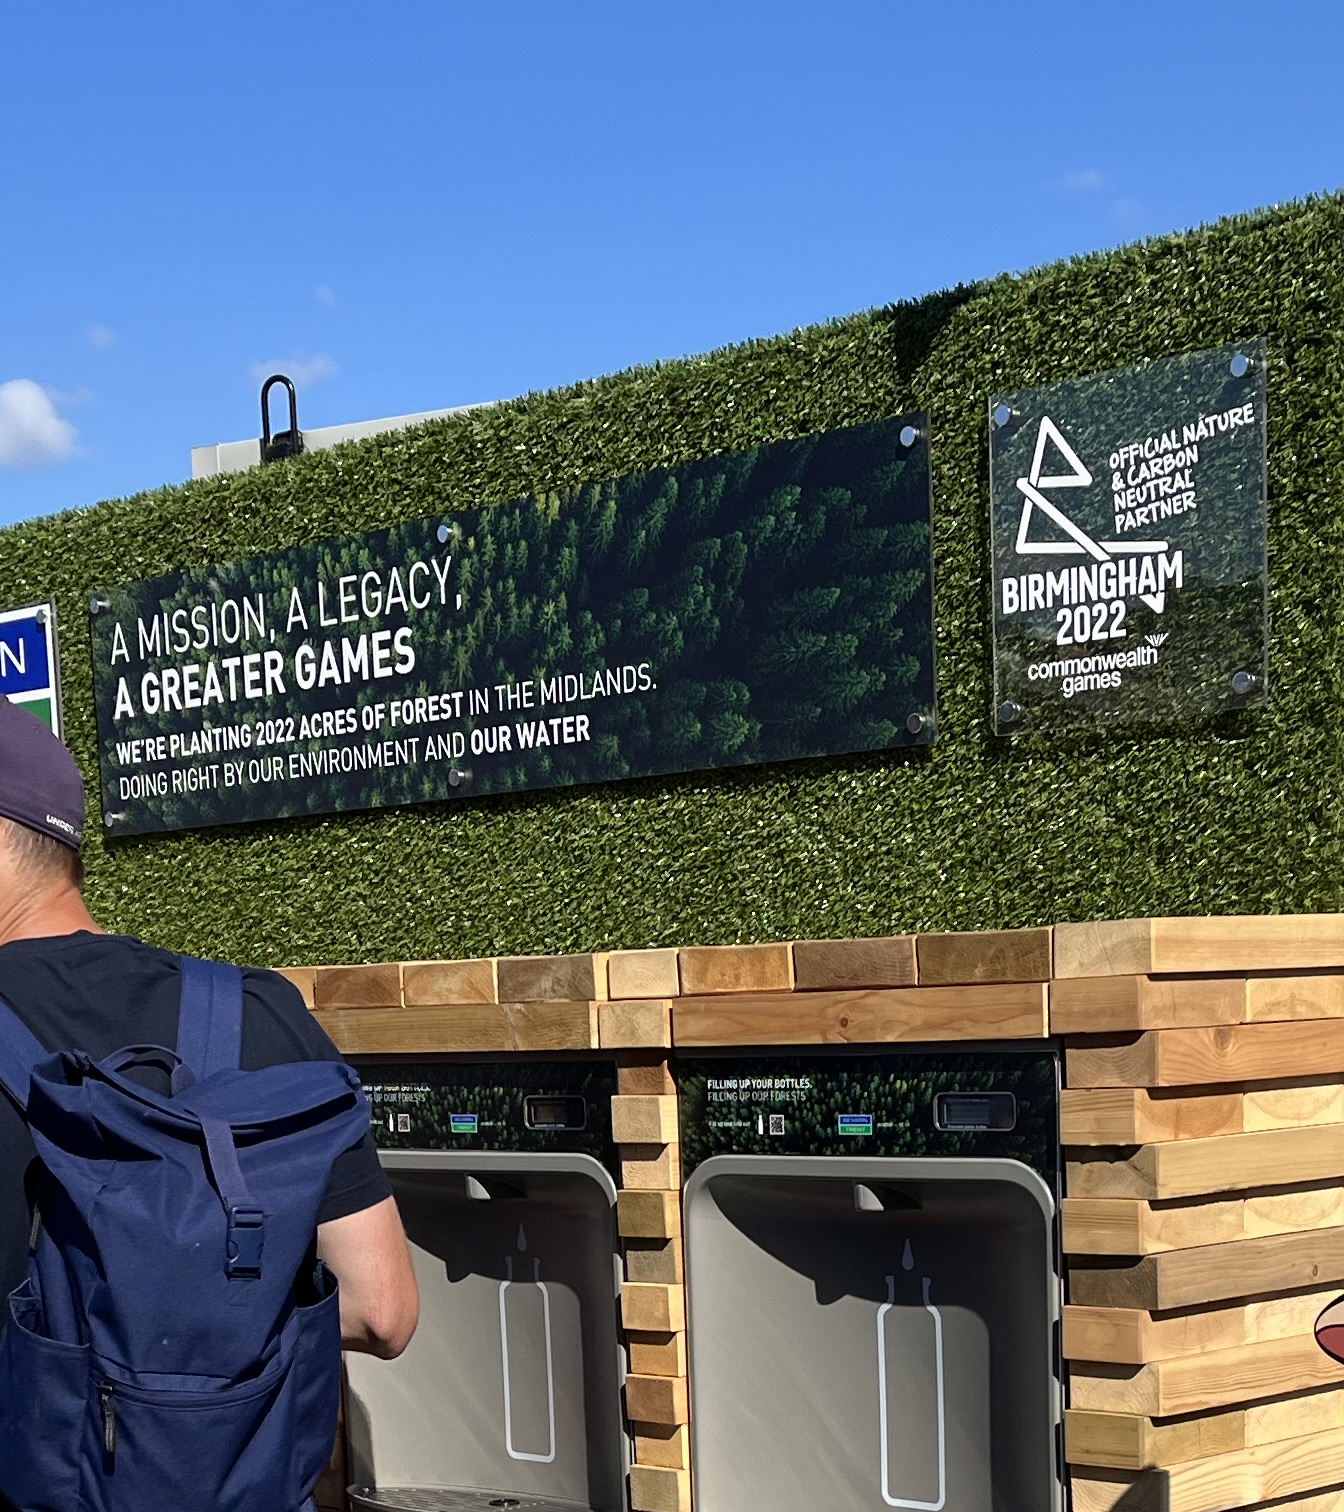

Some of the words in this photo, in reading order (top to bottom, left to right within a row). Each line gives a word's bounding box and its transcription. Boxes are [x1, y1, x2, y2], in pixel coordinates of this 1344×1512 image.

[1110, 430, 1181, 469] OFFICIAL
[1183, 403, 1255, 445] NATURE
[1112, 472, 1126, 491] &
[1127, 444, 1198, 486] CARBON
[1114, 471, 1195, 512] NEUTRAL
[1115, 490, 1197, 533] PARTNER
[1002, 550, 1183, 615] BIRMINGHAM
[111, 622, 130, 666] A
[138, 593, 275, 660] MISSION,
[286, 586, 308, 633] A
[318, 555, 462, 627] LEGACY,
[1057, 600, 1126, 645] 2022
[114, 676, 135, 720] A
[141, 650, 286, 715] GREATER
[295, 626, 416, 690] GAMES
[1027, 646, 1157, 680] commonwealth
[1061, 671, 1122, 699] games
[116, 737, 167, 765] WE'RE
[170, 723, 252, 759] PLANTING
[256, 717, 295, 746] 2022
[299, 707, 357, 740] ACRES
[362, 703, 386, 730] OF
[390, 692, 463, 727] FOREST
[469, 687, 489, 715] IN
[494, 681, 535, 711] THE
[540, 663, 657, 705] MIDLANDS.
[120, 772, 168, 800] DOING
[172, 764, 220, 793] RIGHT
[224, 760, 244, 787] BY
[249, 756, 284, 784] OUR
[290, 738, 419, 779] ENVIRONMENT
[425, 732, 465, 761] AND
[471, 725, 512, 755] OUR
[516, 714, 590, 749] WATER
[707, 1079, 737, 1089] FILLING
[739, 1079, 751, 1089] UP
[751, 1079, 773, 1089] YOUR
